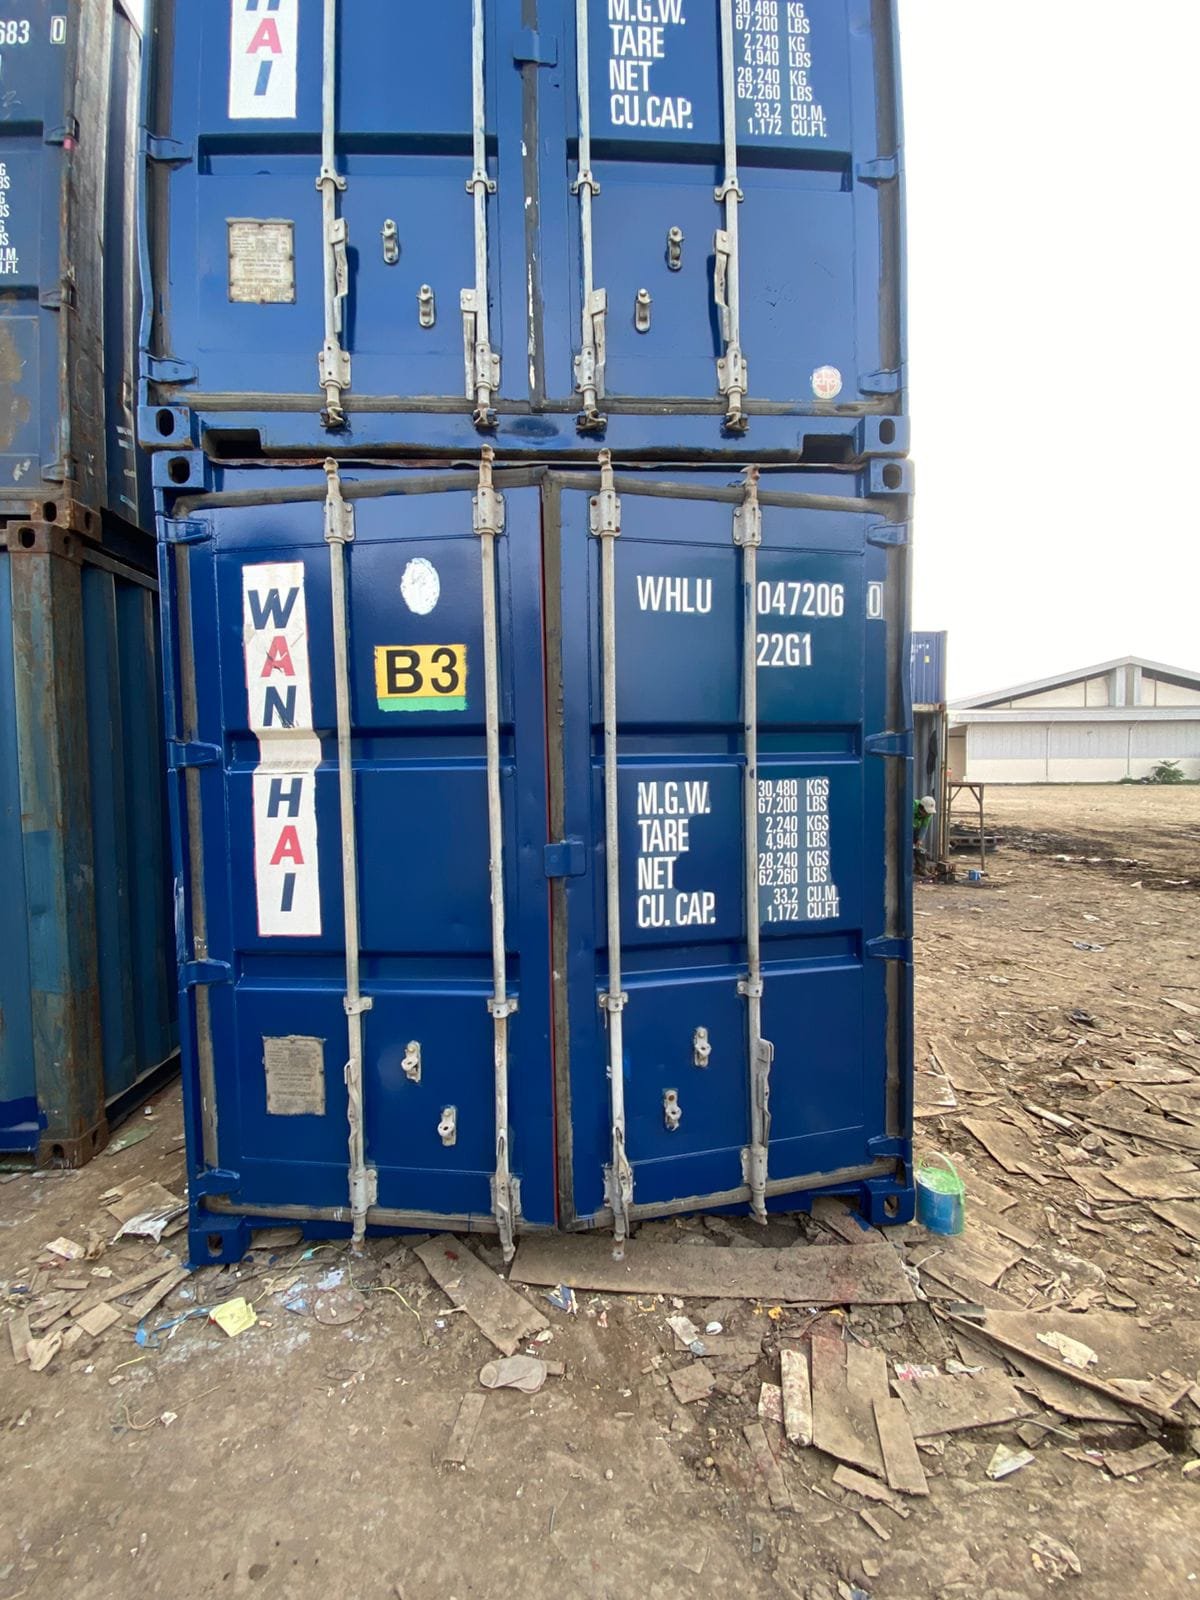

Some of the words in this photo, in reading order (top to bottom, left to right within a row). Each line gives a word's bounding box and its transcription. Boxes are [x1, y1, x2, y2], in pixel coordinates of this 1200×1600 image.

[608, 0, 686, 25] M.G.W.
[735, 0, 778, 17] 30,480
[787, 2, 804, 19] KG
[735, 14, 778, 32] 67,200
[787, 18, 810, 34] LBS
[245, 0, 283, 96] AI
[608, 24, 665, 58] TARE
[743, 33, 779, 51] 2,240
[788, 35, 806, 52] KG
[744, 50, 779, 67] 4,940
[789, 52, 812, 68] LBS
[609, 59, 653, 92] NET
[737, 67, 780, 85] 28,240
[789, 70, 807, 86] KG
[737, 83, 781, 100] 62,260
[790, 85, 812, 102] LBS
[610, 94, 693, 129] CU.CAP.
[754, 103, 781, 119] 33.2
[791, 104, 827, 121] CU.M.
[747, 118, 782, 135] 1,172
[636, 575, 712, 614] WHLU
[757, 580, 845, 617] 047206
[248, 587, 299, 728] WAN
[756, 632, 812, 667] 22G1
[385, 646, 459, 695] B3
[637, 781, 711, 815] M.G.W.
[758, 779, 798, 798] 30,480
[806, 779, 829, 796] KGS
[758, 796, 798, 815] 67,200
[806, 796, 827, 812] LBS
[765, 816, 798, 834] 2,240
[806, 815, 829, 831] KGS
[266, 777, 305, 912] HAI
[638, 818, 690, 853] TARE
[765, 832, 798, 850] 4,940
[806, 831, 827, 848] LBS
[758, 851, 798, 870] 28,240
[806, 850, 829, 867] KGS
[638, 856, 677, 890] NET
[758, 868, 798, 886] 62,260
[807, 867, 827, 884] LBS
[773, 888, 798, 905] 33.2
[807, 885, 840, 902] CU.M.
[767, 904, 798, 922] 1,172
[807, 901, 840, 918] CU.FT.
